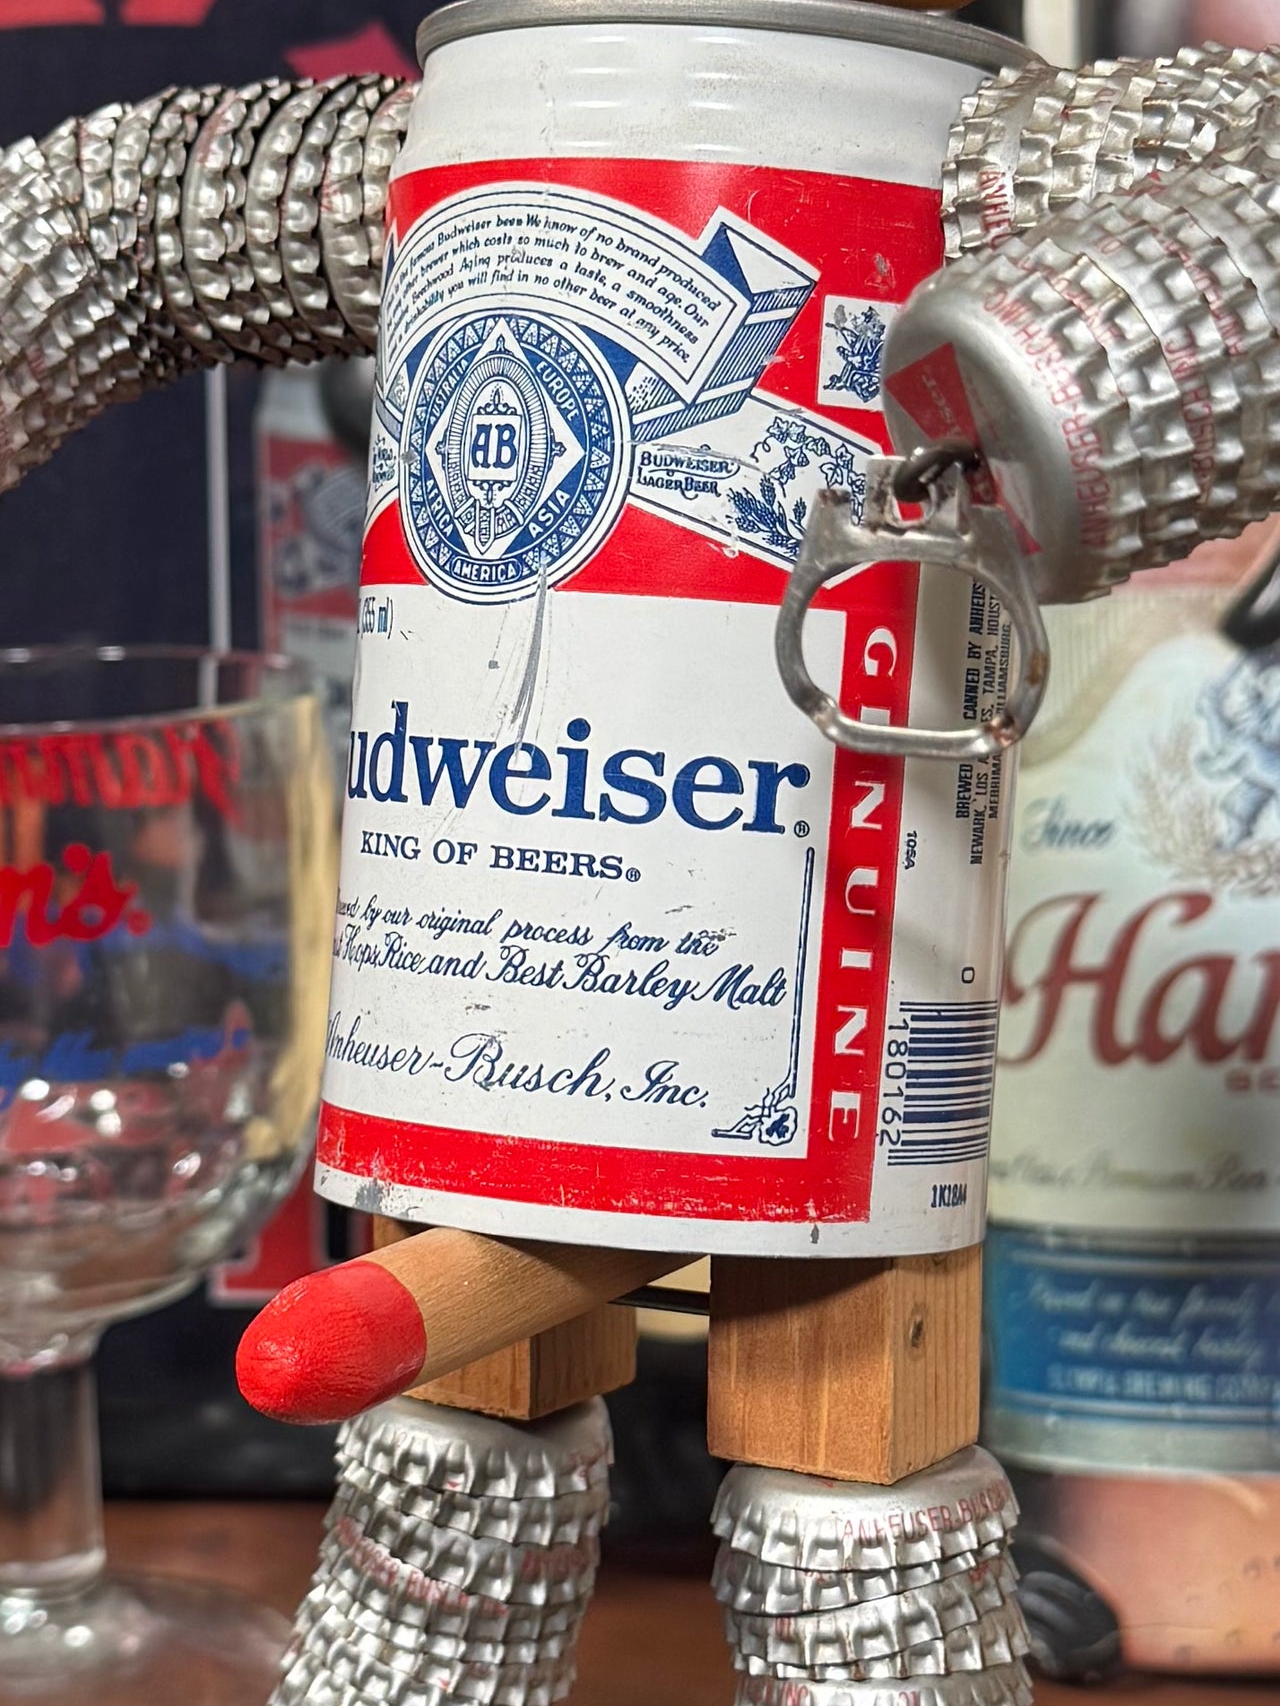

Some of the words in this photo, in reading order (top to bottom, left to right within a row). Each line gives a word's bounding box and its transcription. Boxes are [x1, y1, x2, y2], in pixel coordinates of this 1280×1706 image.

[437, 220, 492, 247] Budweiser
[526, 213, 540, 227] We
[543, 216, 578, 234] know
[579, 226, 597, 242] of
[596, 234, 613, 247] no
[615, 238, 660, 268] brand
[655, 264, 721, 312] produced
[452, 237, 480, 257] which
[484, 233, 512, 247] costs
[517, 234, 530, 245] so
[535, 236, 569, 252] much
[575, 241, 587, 256] to
[590, 247, 625, 270] brew
[627, 268, 658, 289] and
[657, 284, 683, 309] age.
[683, 303, 710, 329] Our
[459, 255, 491, 272] Aging
[497, 250, 554, 269] produces
[560, 261, 569, 271] a
[574, 259, 607, 287] taste,
[611, 282, 622, 293] a
[626, 289, 699, 345] smoothness
[468, 271, 488, 287] will
[491, 269, 513, 285] find
[517, 269, 529, 283] in
[534, 273, 549, 286] no
[553, 277, 588, 297] other
[589, 288, 617, 310] beer
[620, 305, 634, 320] at
[636, 317, 660, 340] any
[657, 335, 690, 364] price.
[430, 359, 470, 425] AUSTRALIA
[536, 361, 580, 422] EUROPE
[471, 423, 517, 469] AB
[640, 451, 733, 474] BUDWEISER
[425, 479, 454, 537] AFRICA
[528, 491, 570, 538] ASIA
[453, 559, 517, 582] AMERICA
[987, 593, 1002, 637] HOUST
[967, 642, 983, 661] BY
[982, 645, 999, 695] TAMPA,
[962, 667, 981, 721] CANNED
[348, 701, 811, 834] udweiser
[955, 763, 974, 819] BREWED
[975, 772, 989, 798] LOS
[989, 754, 1002, 820] MERRIMA
[361, 831, 421, 860] KING
[433, 839, 478, 866] OF
[360, 894, 382, 930] by
[381, 907, 413, 926] our
[416, 908, 503, 940] original
[498, 919, 593, 944] process
[596, 921, 669, 954] from
[675, 931, 720, 956] the
[424, 950, 487, 979] and
[485, 944, 566, 989] Best
[562, 952, 701, 1010] Barley
[692, 963, 787, 1010] Malt
[620, 1060, 709, 1108] Inc.
[879, 1018, 910, 1147] 180162
